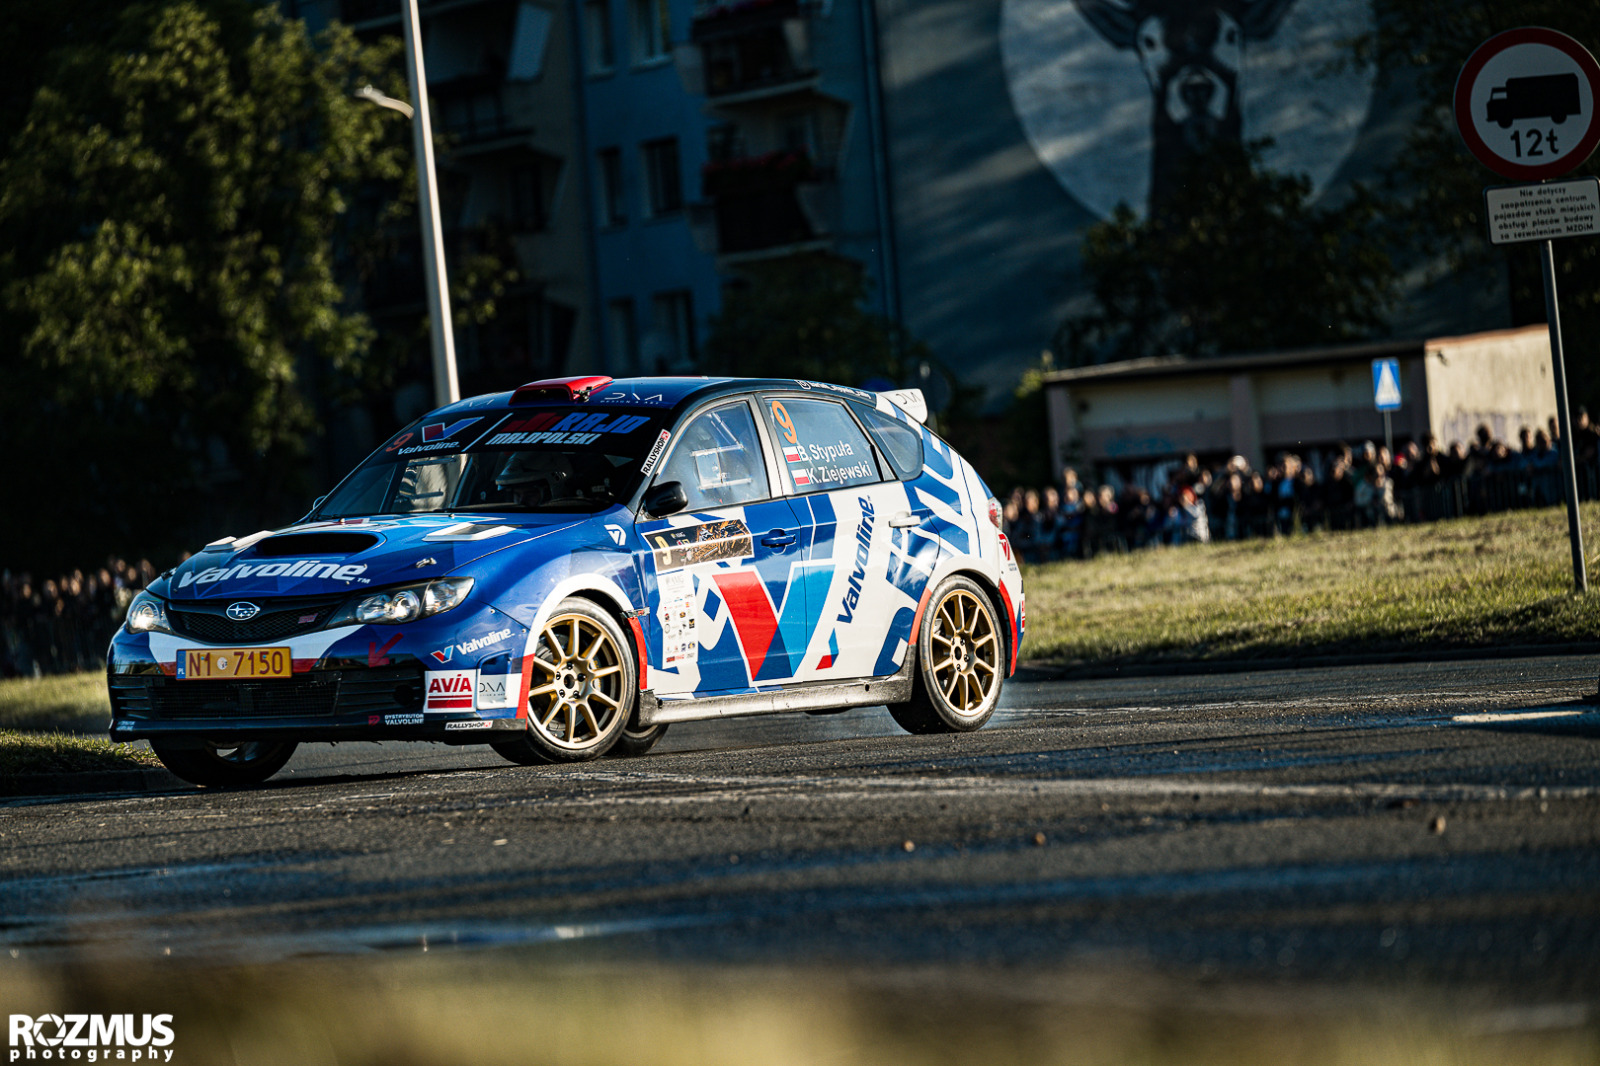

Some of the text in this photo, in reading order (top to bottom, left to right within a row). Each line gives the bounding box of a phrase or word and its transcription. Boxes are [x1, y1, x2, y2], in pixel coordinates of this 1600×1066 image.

[1538, 187, 1566, 196] dotyczy
[1556, 195, 1587, 204] centrum
[1494, 210, 1531, 221] pojazdów
[1560, 203, 1596, 214] miejskich
[1498, 214, 1594, 230] obsługi placów budowy
[549, 412, 650, 434] RAJD
[771, 400, 797, 444] 9
[386, 432, 415, 453] 9
[398, 441, 458, 455] Valvoline
[798, 440, 854, 463] B.Stypuła
[806, 460, 873, 484] K.Ziejewski
[836, 496, 875, 624] Valvoline
[178, 560, 367, 588] Valvoline
[456, 628, 513, 655] Valvoline
[233, 651, 283, 676] 7150
